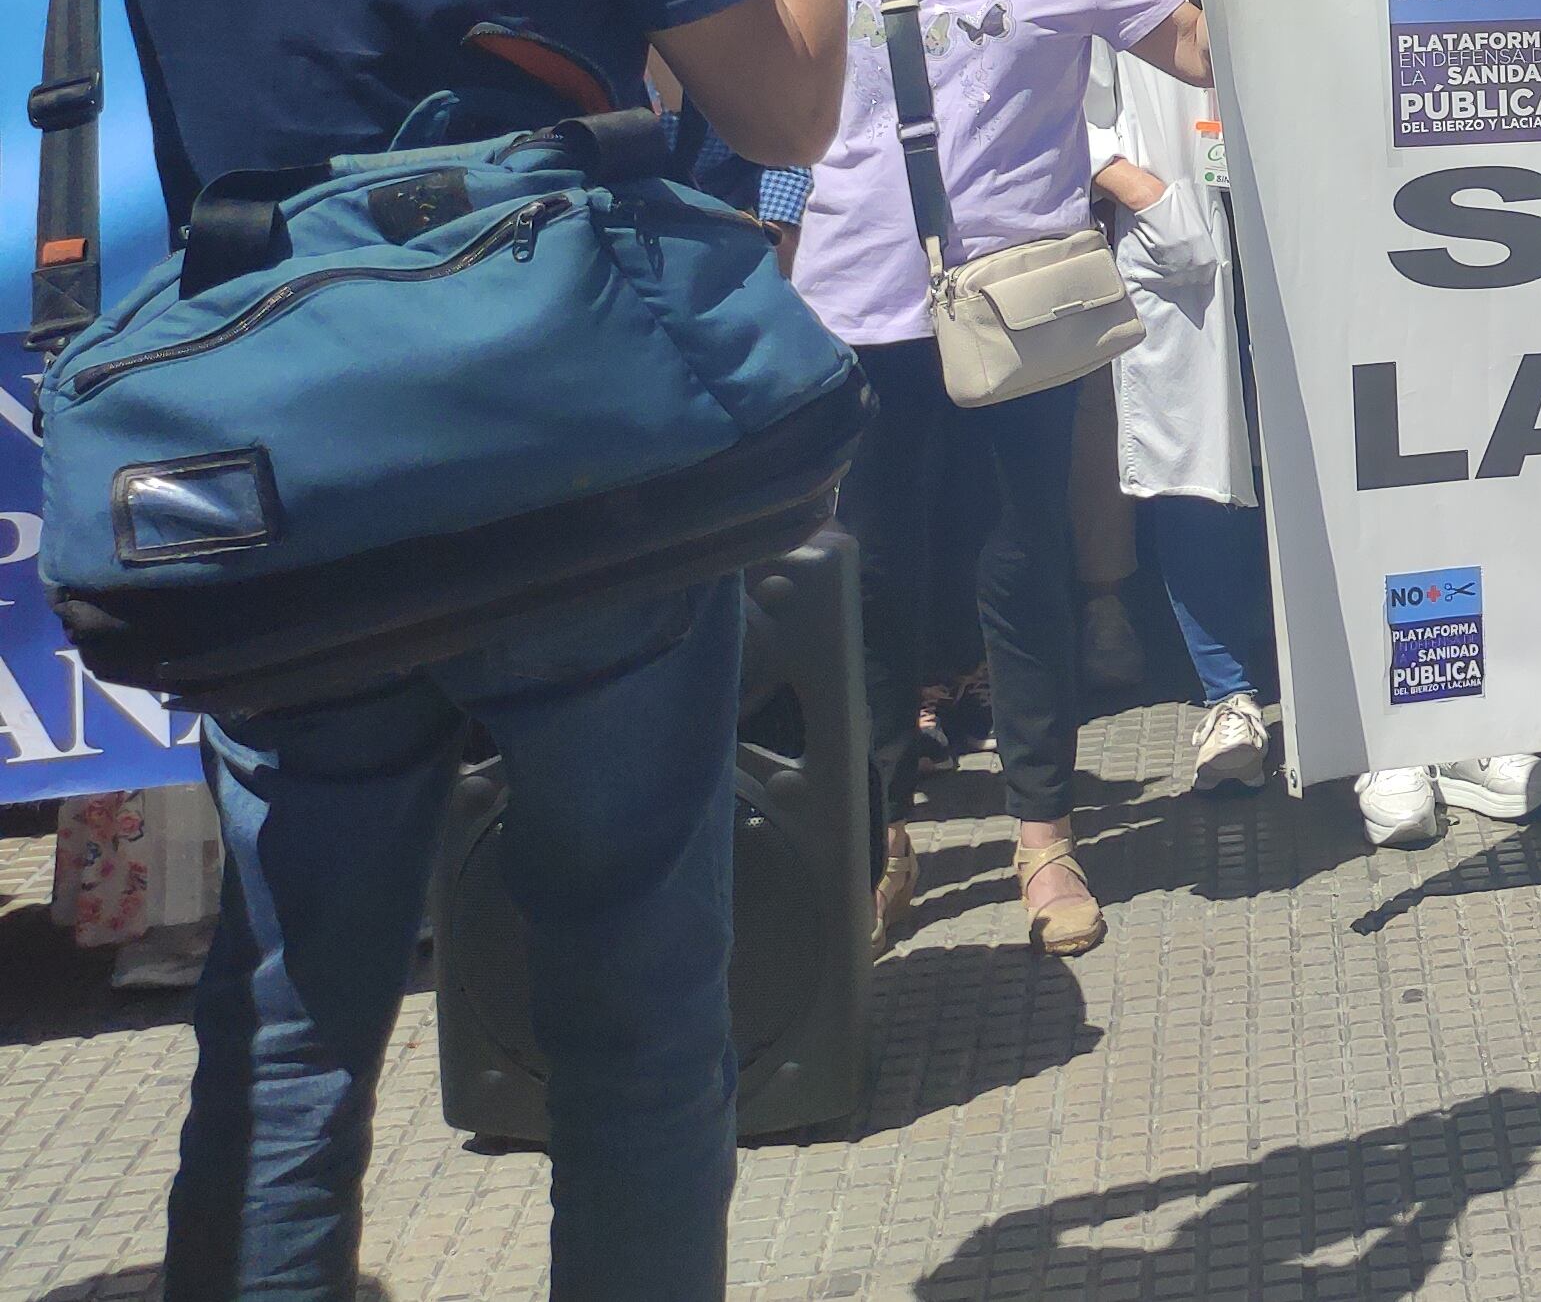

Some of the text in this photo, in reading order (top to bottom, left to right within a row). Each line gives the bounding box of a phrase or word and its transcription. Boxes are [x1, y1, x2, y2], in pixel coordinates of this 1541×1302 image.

[1400, 53, 1426, 68] EN
[1433, 49, 1527, 67] DEFENSA
[1401, 70, 1426, 86] LA
[1401, 122, 1429, 134] DEL
[1432, 119, 1484, 132] BIERZO
[1484, 119, 1497, 130] Y
[1392, 622, 1478, 643] PLATAFORMA
[1418, 644, 1479, 663] SANIDAD
[1393, 659, 1482, 688] PÚBLICA
